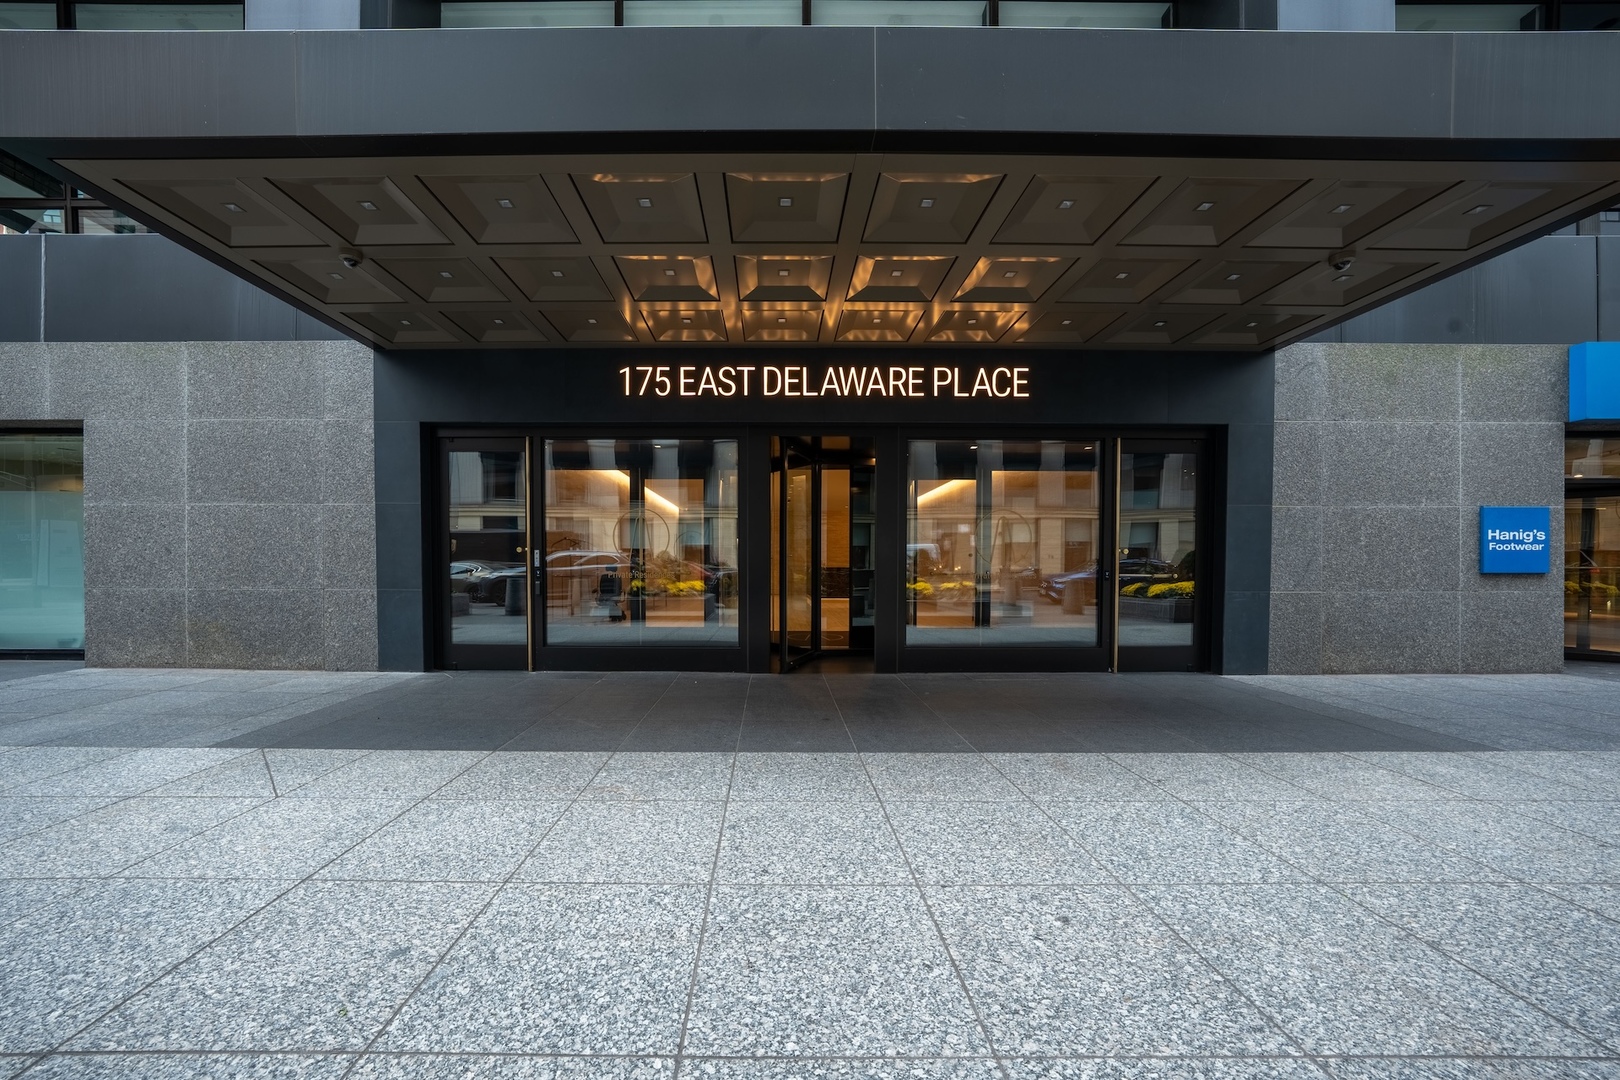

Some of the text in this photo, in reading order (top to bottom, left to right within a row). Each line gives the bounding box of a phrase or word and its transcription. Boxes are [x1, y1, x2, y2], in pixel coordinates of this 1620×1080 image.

[619, 366, 1031, 398] 175 EAST DELAWARE PLACE
[1487, 529, 1546, 543] Hanig's
[1488, 542, 1545, 551] Footwear
[607, 570, 633, 579] Private
